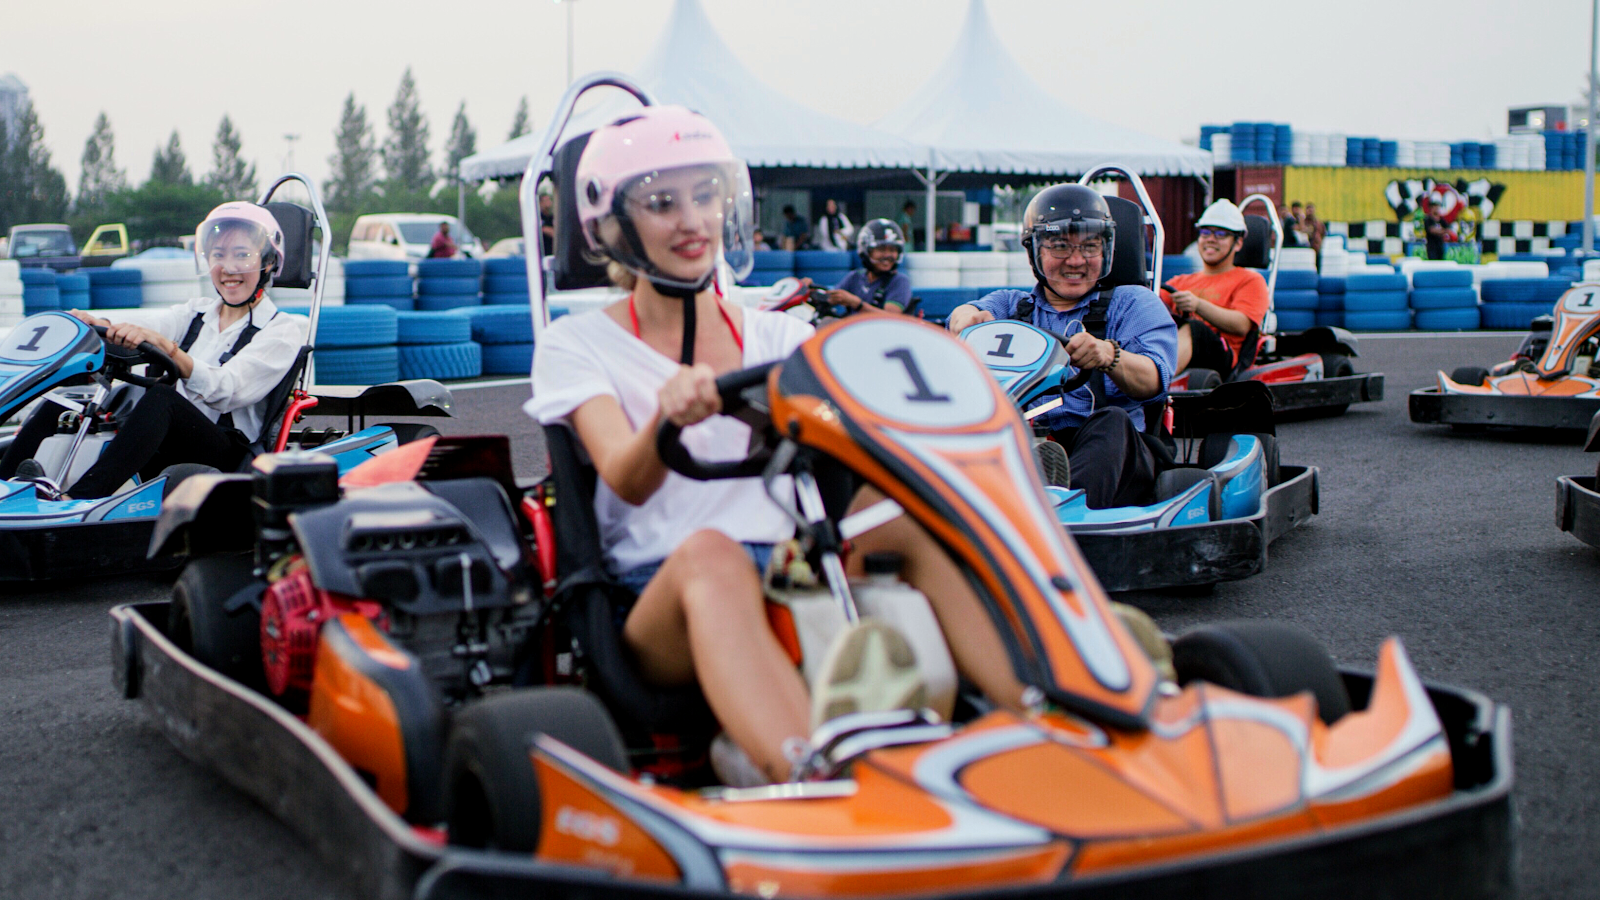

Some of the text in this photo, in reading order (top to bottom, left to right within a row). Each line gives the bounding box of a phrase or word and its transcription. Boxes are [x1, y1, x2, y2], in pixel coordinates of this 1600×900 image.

[1577, 292, 1595, 307] 1
[16, 325, 50, 352] 1
[986, 333, 1015, 358] 1
[883, 347, 951, 402] 1
[128, 500, 156, 513] EGS
